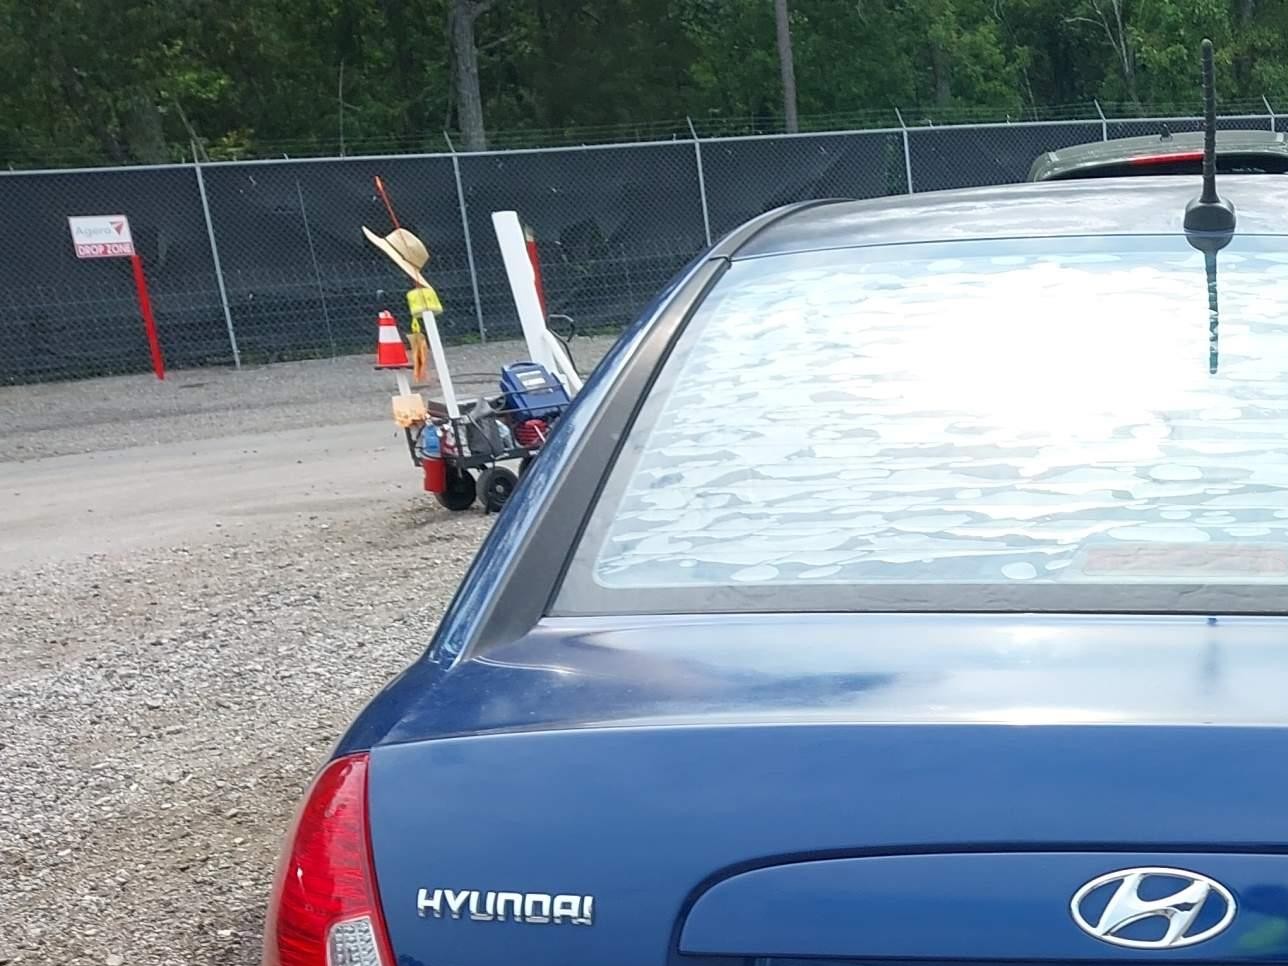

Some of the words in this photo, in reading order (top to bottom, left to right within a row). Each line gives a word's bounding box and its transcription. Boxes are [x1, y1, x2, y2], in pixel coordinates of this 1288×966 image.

[78, 244, 104, 256] DROP
[106, 243, 132, 255] ZONE
[417, 888, 594, 926] HYUNDAI
